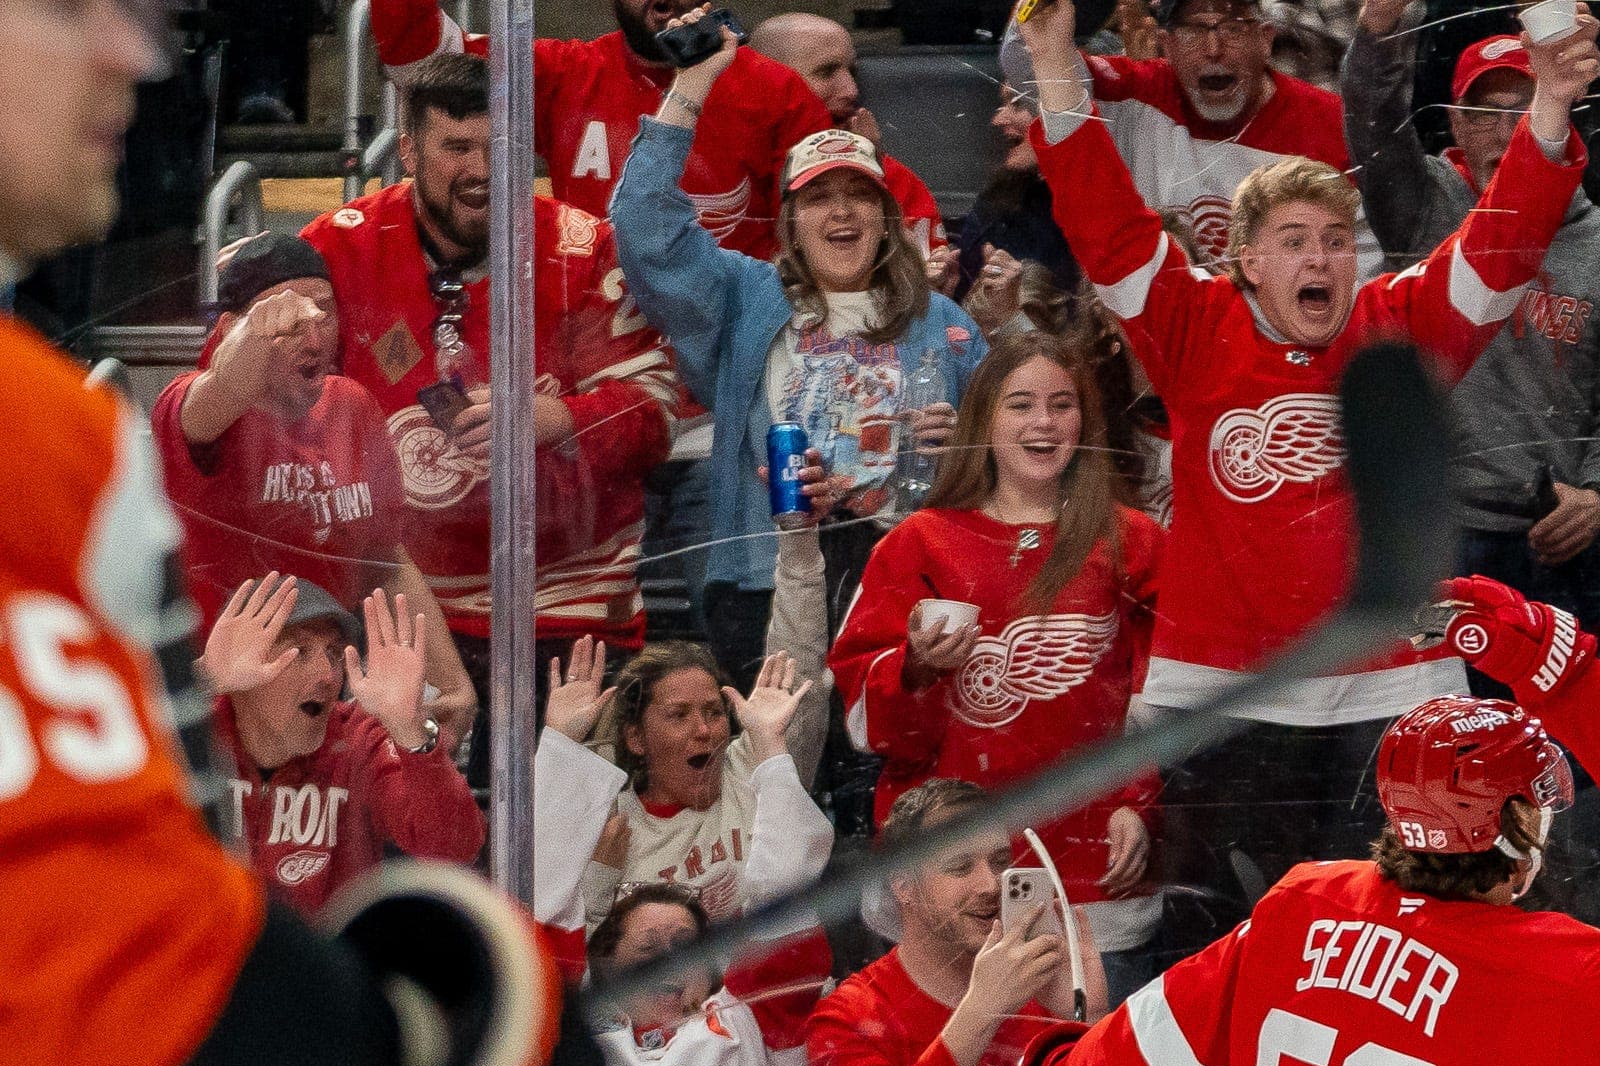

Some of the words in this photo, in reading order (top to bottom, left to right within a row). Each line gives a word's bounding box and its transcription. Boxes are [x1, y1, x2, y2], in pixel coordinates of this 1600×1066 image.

[571, 120, 612, 180] A
[1400, 821, 1427, 848] 53
[1296, 918, 1460, 1039] SEIDER
